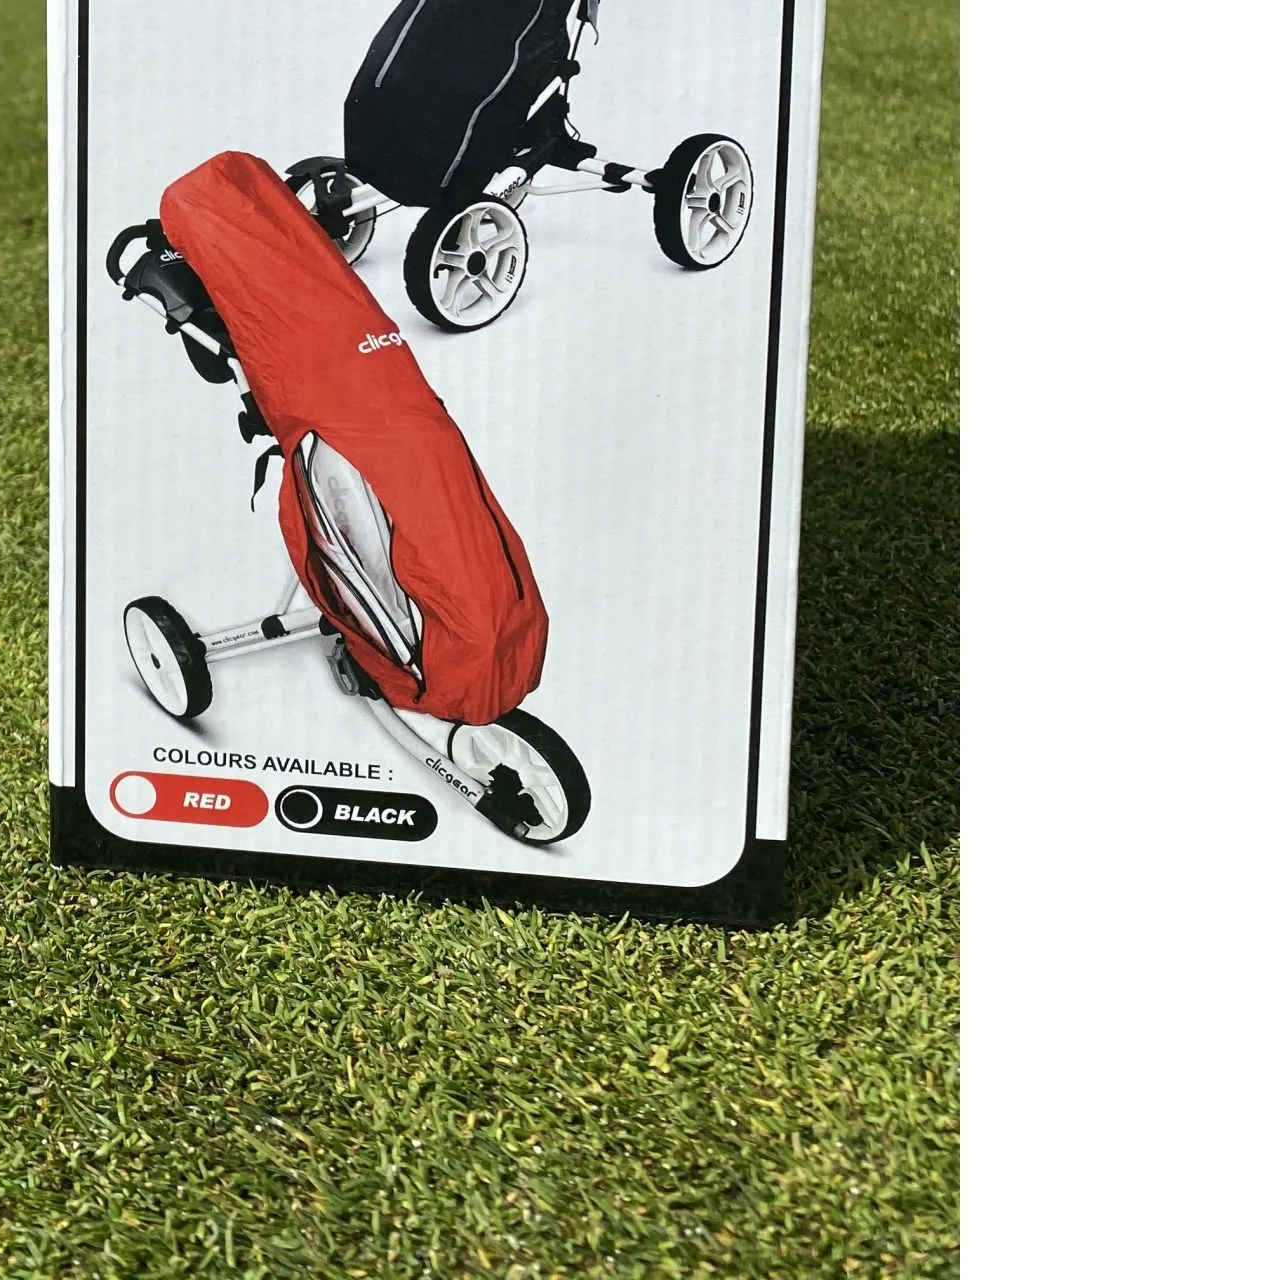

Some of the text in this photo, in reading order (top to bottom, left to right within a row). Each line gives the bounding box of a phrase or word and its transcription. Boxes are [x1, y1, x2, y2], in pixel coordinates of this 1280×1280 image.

[153, 747, 257, 769] COLOURS
[262, 756, 381, 780] AVAILABLE
[425, 757, 478, 797] clicgear
[182, 791, 232, 810] RED
[334, 803, 416, 827] BLACK
